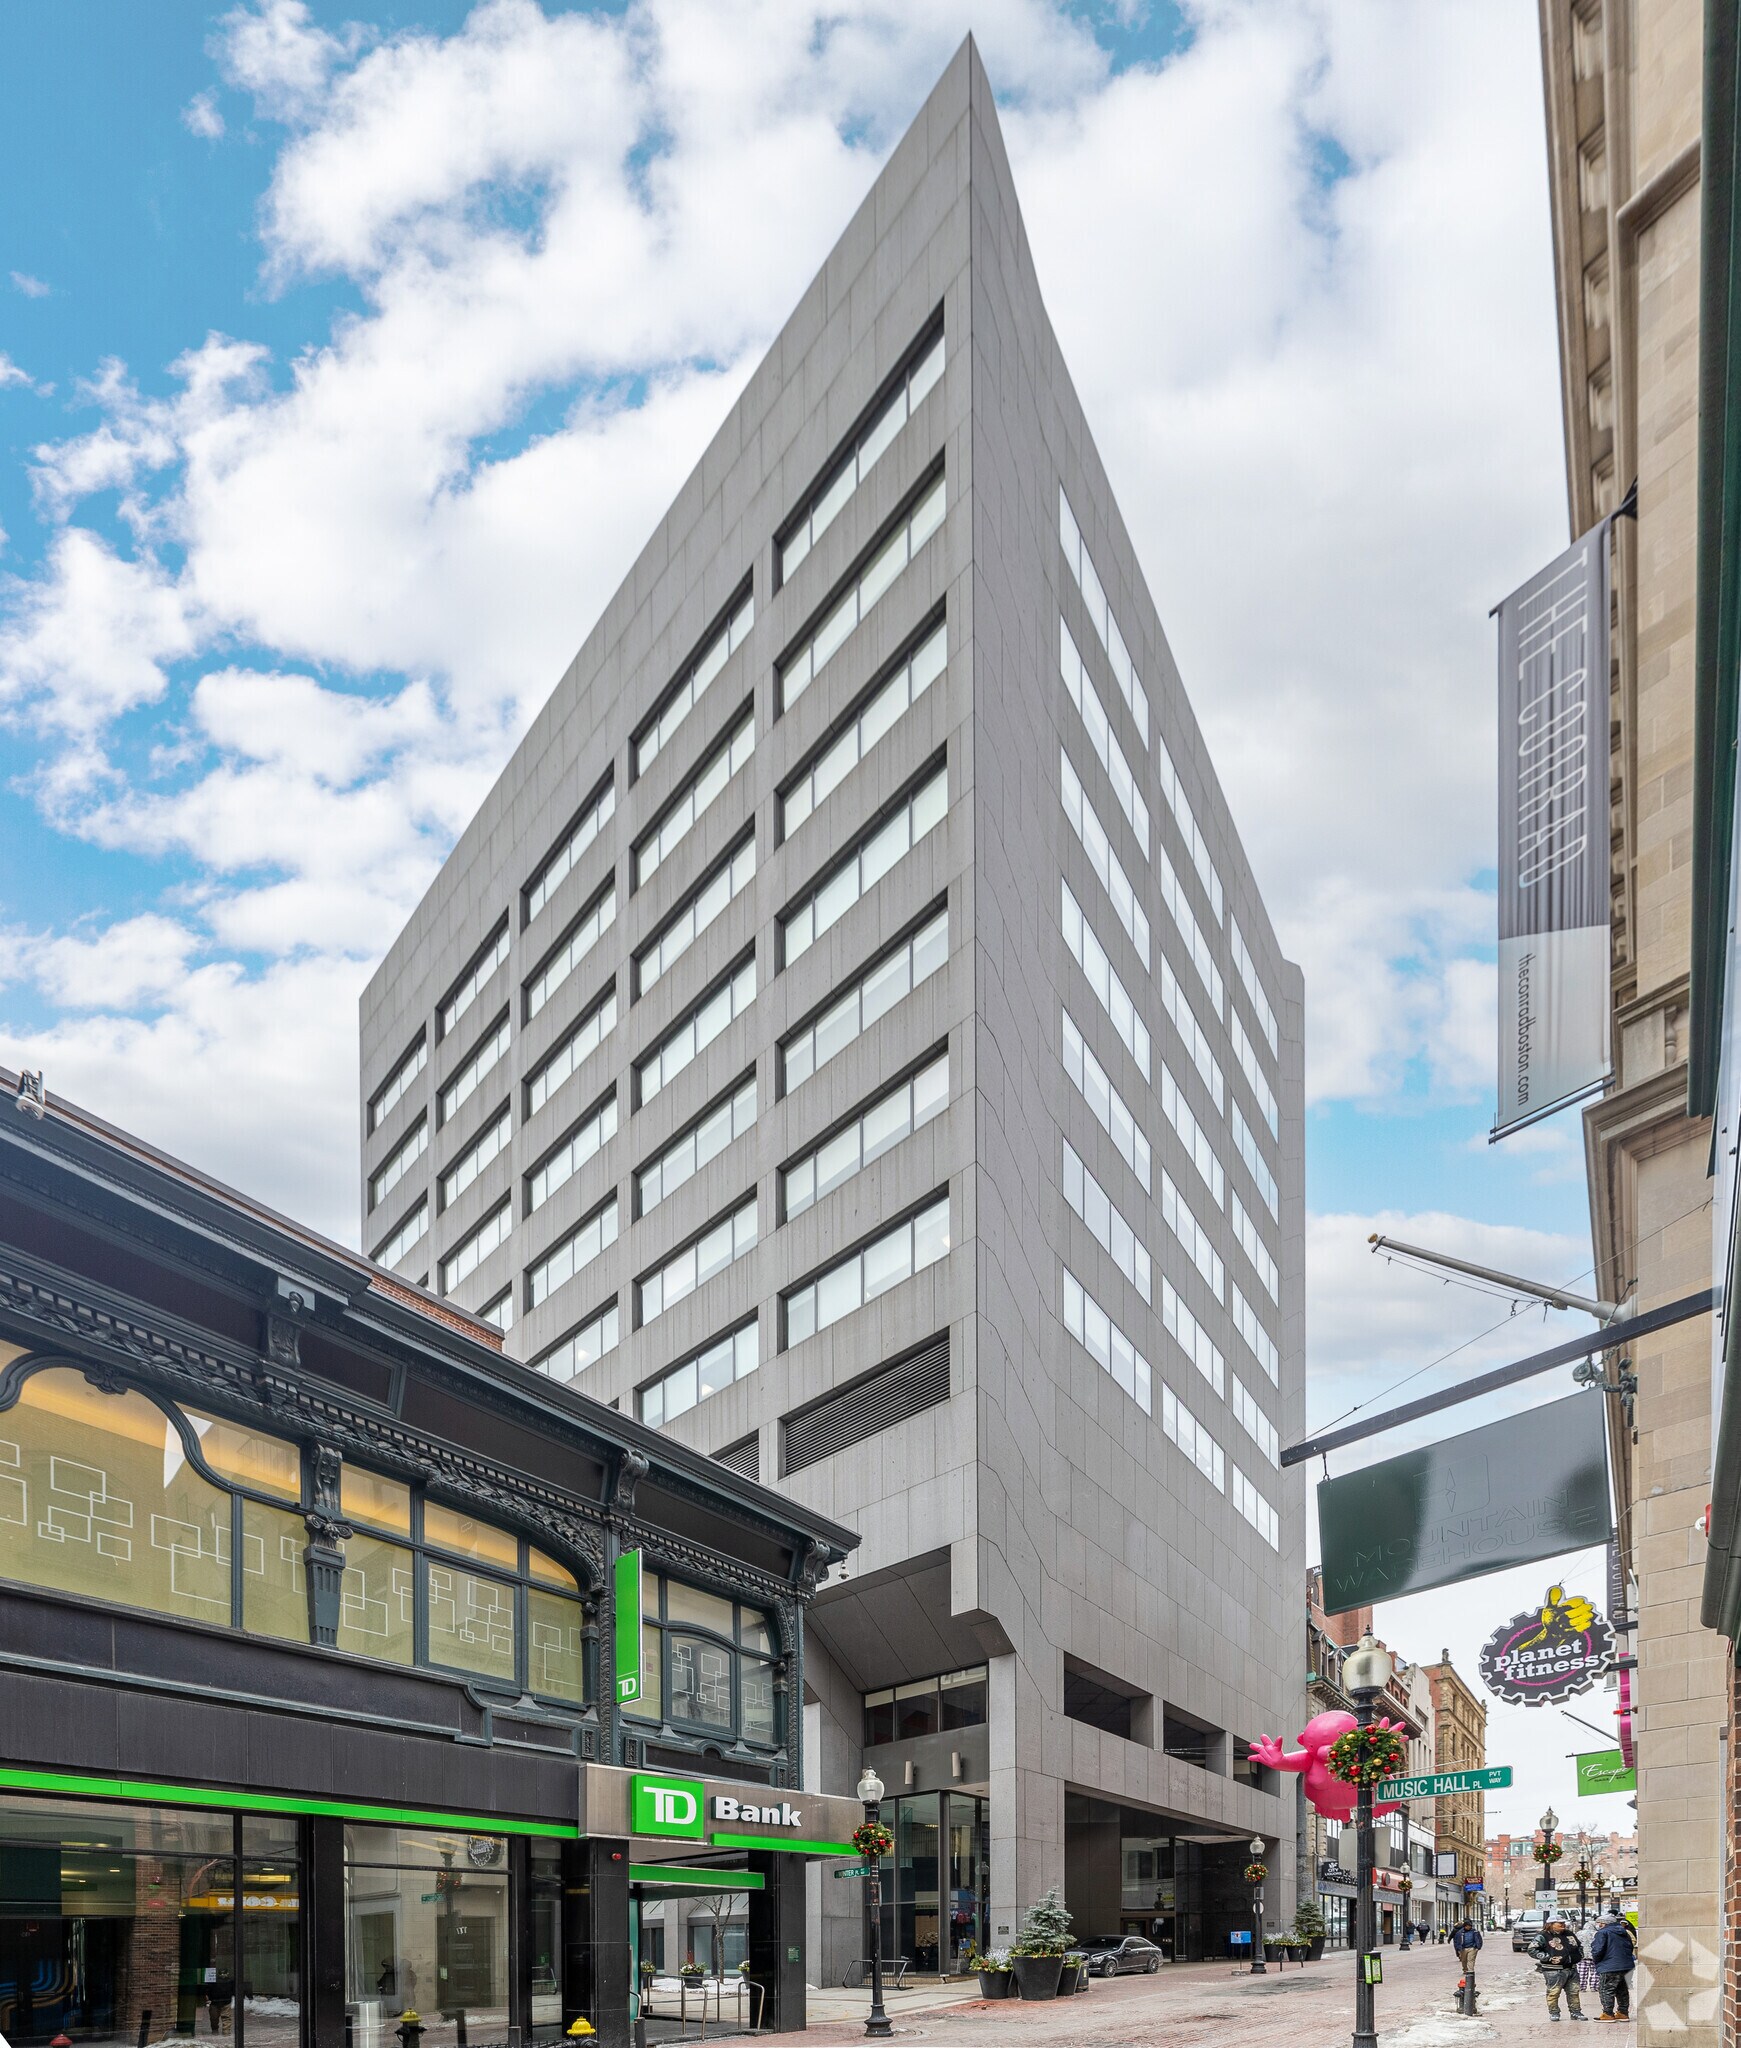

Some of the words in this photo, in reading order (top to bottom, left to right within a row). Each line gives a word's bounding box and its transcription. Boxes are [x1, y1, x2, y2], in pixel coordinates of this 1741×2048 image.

[1518, 546, 1588, 682] THE
[1518, 667, 1588, 889] CONRAD
[1518, 953, 1536, 1107] theconradboston.com
[1355, 1489, 1571, 1568] MOUNTAIN
[1494, 1638, 1583, 1673] planet
[1504, 1654, 1600, 1682] fitness
[618, 1677, 637, 1697] TD
[1383, 1779, 1428, 1799] MUSIC
[1433, 1775, 1471, 1794] HALL
[1472, 1780, 1483, 1789] PL
[1488, 1770, 1502, 1778] PVT
[1488, 1777, 1502, 1785] WAY
[643, 1786, 697, 1825] TD
[715, 1796, 802, 1827] Bank
